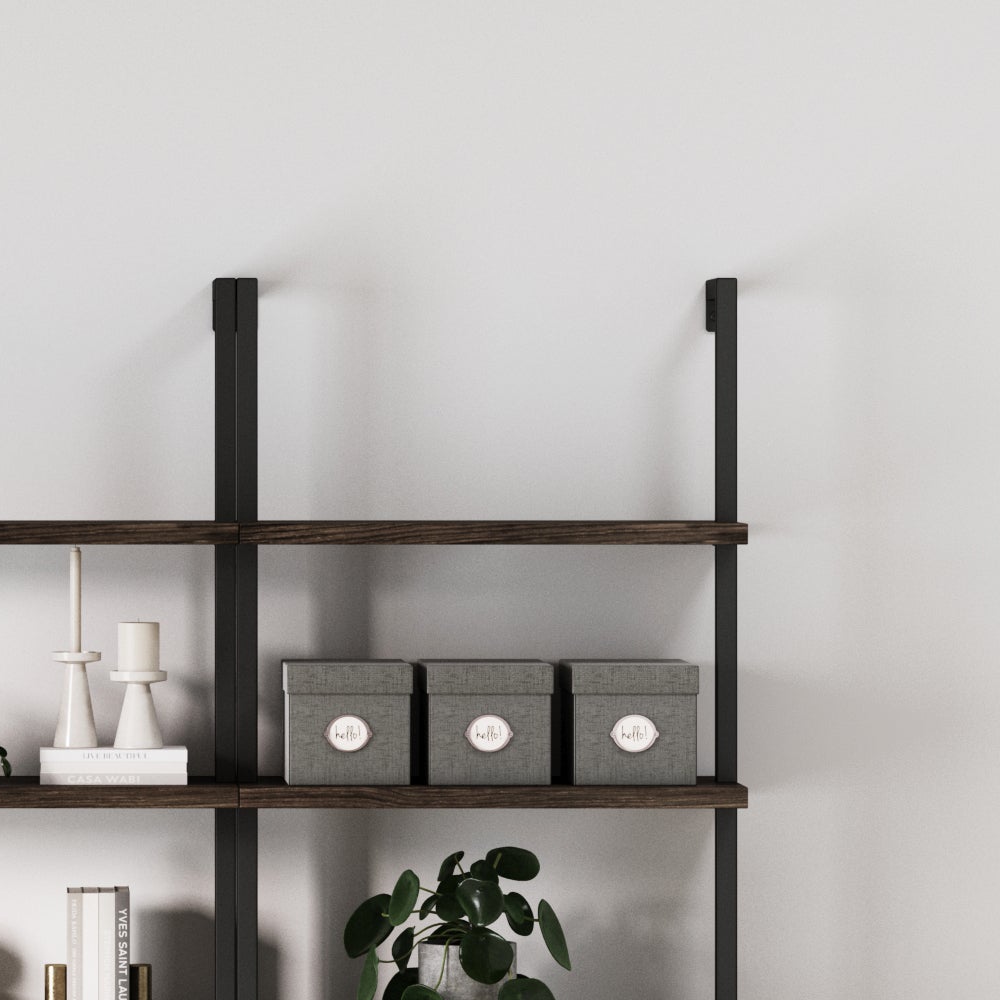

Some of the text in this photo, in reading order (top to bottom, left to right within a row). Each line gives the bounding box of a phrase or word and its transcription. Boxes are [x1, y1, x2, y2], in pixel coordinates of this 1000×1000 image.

[335, 724, 361, 742] hello!
[476, 724, 502, 742] hello!
[620, 724, 647, 742] hello!
[67, 775, 141, 784] CASA WABI
[118, 908, 128, 938] YVES
[118, 941, 128, 975] SAINT
